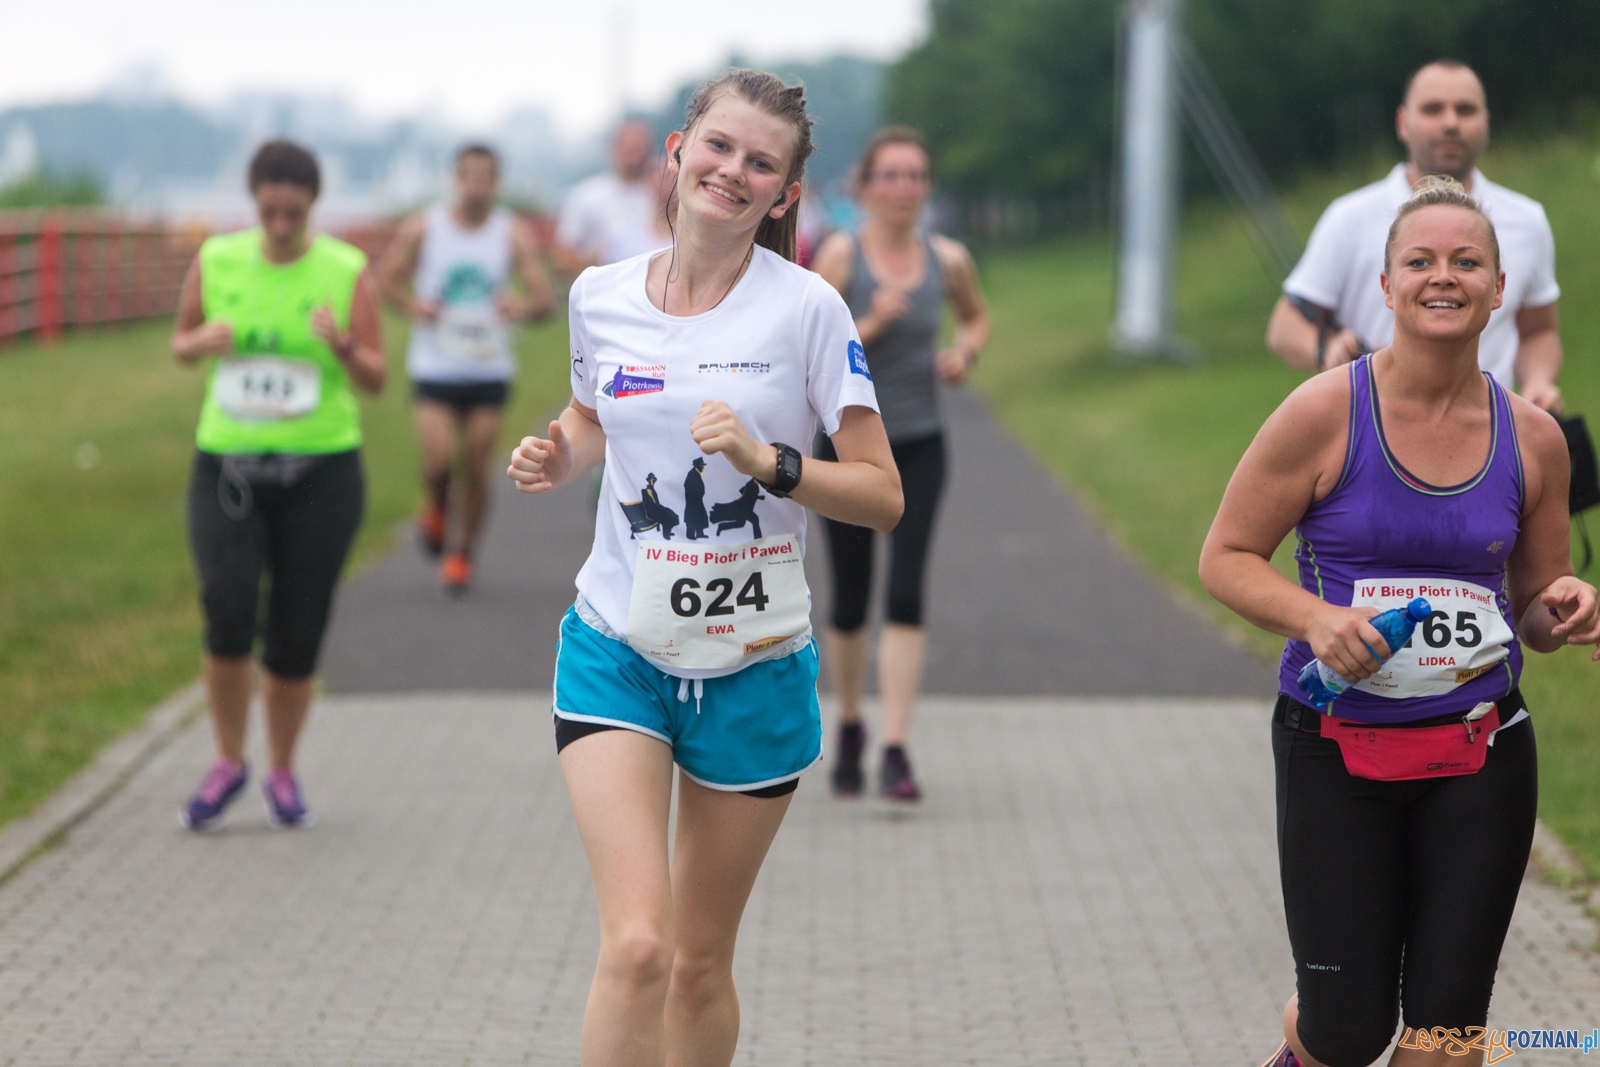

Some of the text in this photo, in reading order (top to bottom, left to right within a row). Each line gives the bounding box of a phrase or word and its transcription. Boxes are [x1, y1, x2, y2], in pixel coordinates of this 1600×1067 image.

[626, 365, 666, 373] ROSSMANN
[622, 380, 663, 390] Piotrkowska
[1486, 541, 1504, 554] 4F
[646, 542, 792, 567] IV Bieg Piotr i Paweł
[670, 571, 769, 618] 624
[1361, 586, 1376, 597] IV
[1381, 586, 1414, 599] Bieg
[1419, 586, 1451, 597] Piotr
[1455, 587, 1459, 597] i
[706, 624, 735, 635] EWA
[1400, 610, 1483, 649] 65
[1418, 657, 1456, 666] LIDKA
